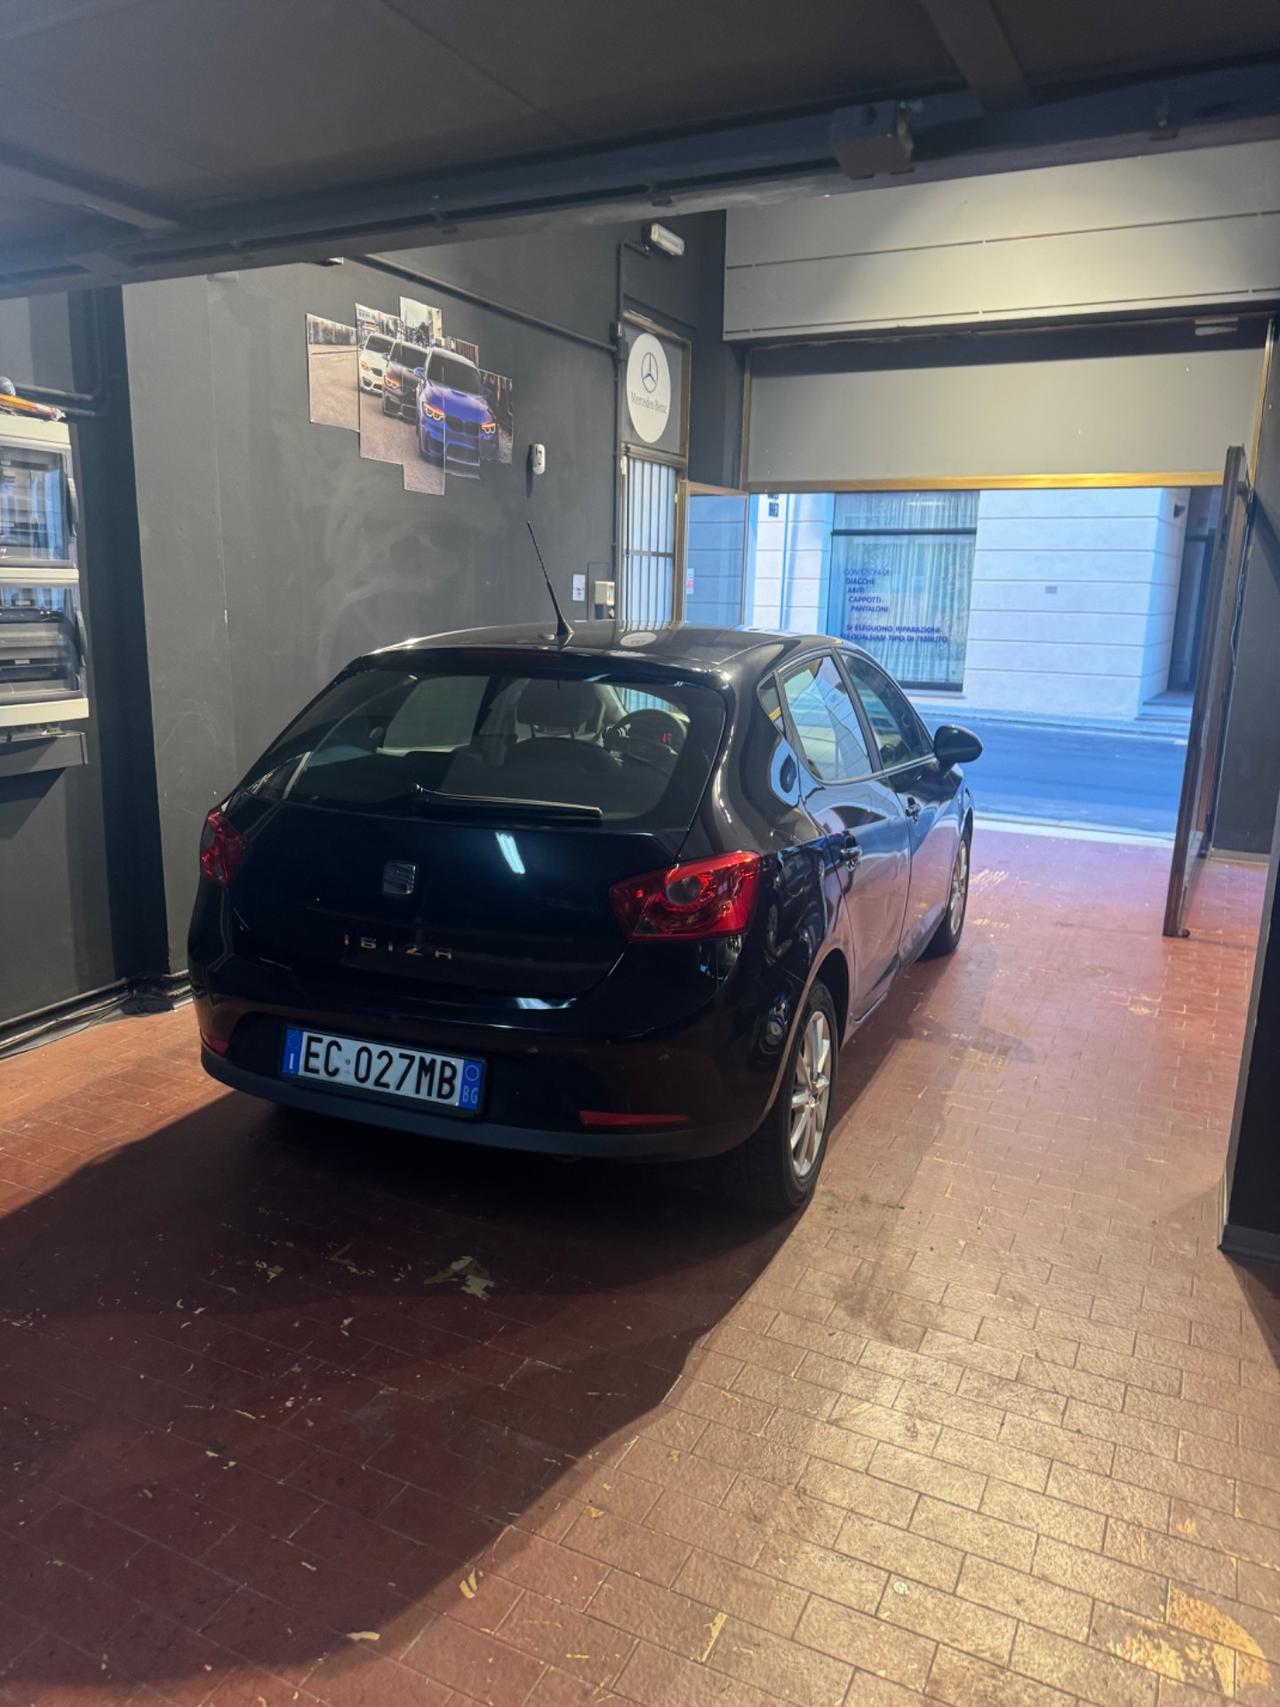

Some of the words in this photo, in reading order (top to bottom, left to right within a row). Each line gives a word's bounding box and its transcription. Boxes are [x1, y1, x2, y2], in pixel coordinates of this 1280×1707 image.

[848, 595, 882, 603] CAPPOTTI
[850, 605, 889, 613] PANTALONI
[303, 1035, 342, 1078] EC
[353, 1046, 459, 1101] 027MB
[462, 1084, 479, 1105] BG
